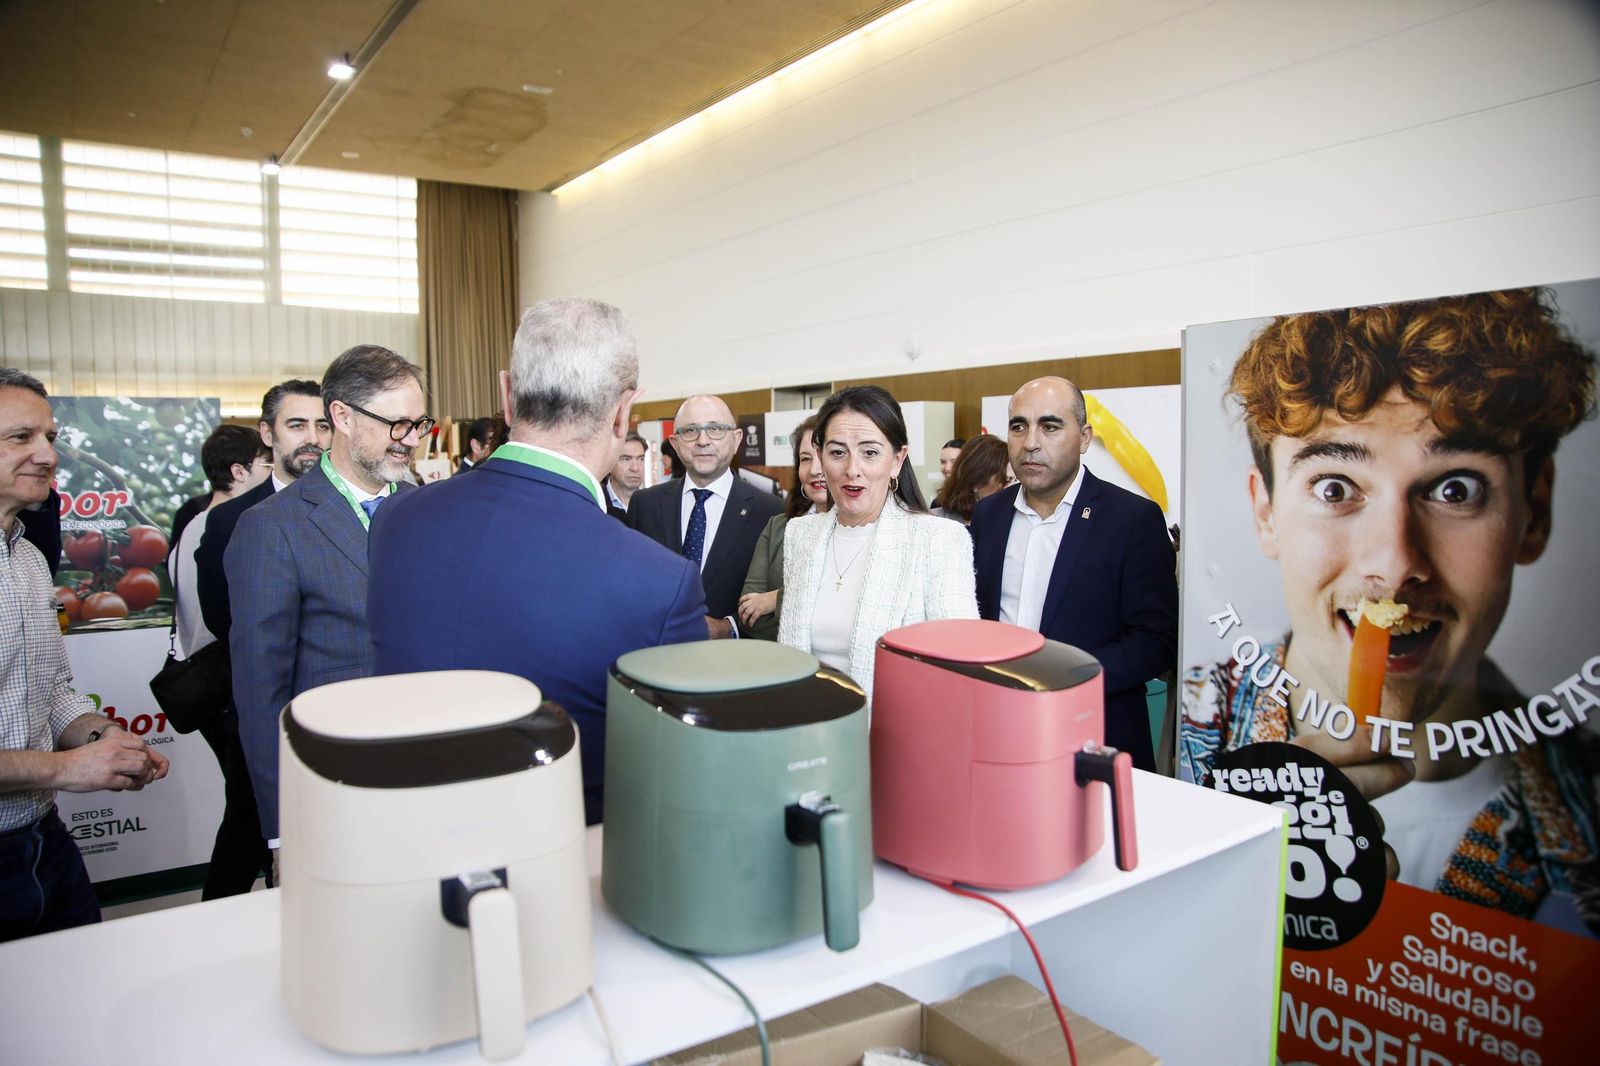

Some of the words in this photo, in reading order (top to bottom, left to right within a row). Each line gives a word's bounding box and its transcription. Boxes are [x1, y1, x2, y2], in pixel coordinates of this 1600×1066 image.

[1207, 602, 1242, 639] A
[1231, 635, 1299, 709] QUE
[1296, 688, 1357, 742] NO
[1365, 714, 1416, 760] TE
[1212, 762, 1325, 796] ready
[71, 810, 99, 822] ESTO
[100, 807, 114, 818] ES
[1284, 912, 1338, 941] nica
[1429, 912, 1537, 973] Snack,
[1366, 958, 1384, 983] y
[1389, 961, 1544, 1038] Saludable
[1402, 934, 1536, 1001] Sabroso
[1289, 960, 1321, 985] en
[1327, 967, 1348, 996] la
[1355, 982, 1446, 1035] misma
[1453, 1016, 1542, 1066] frase
